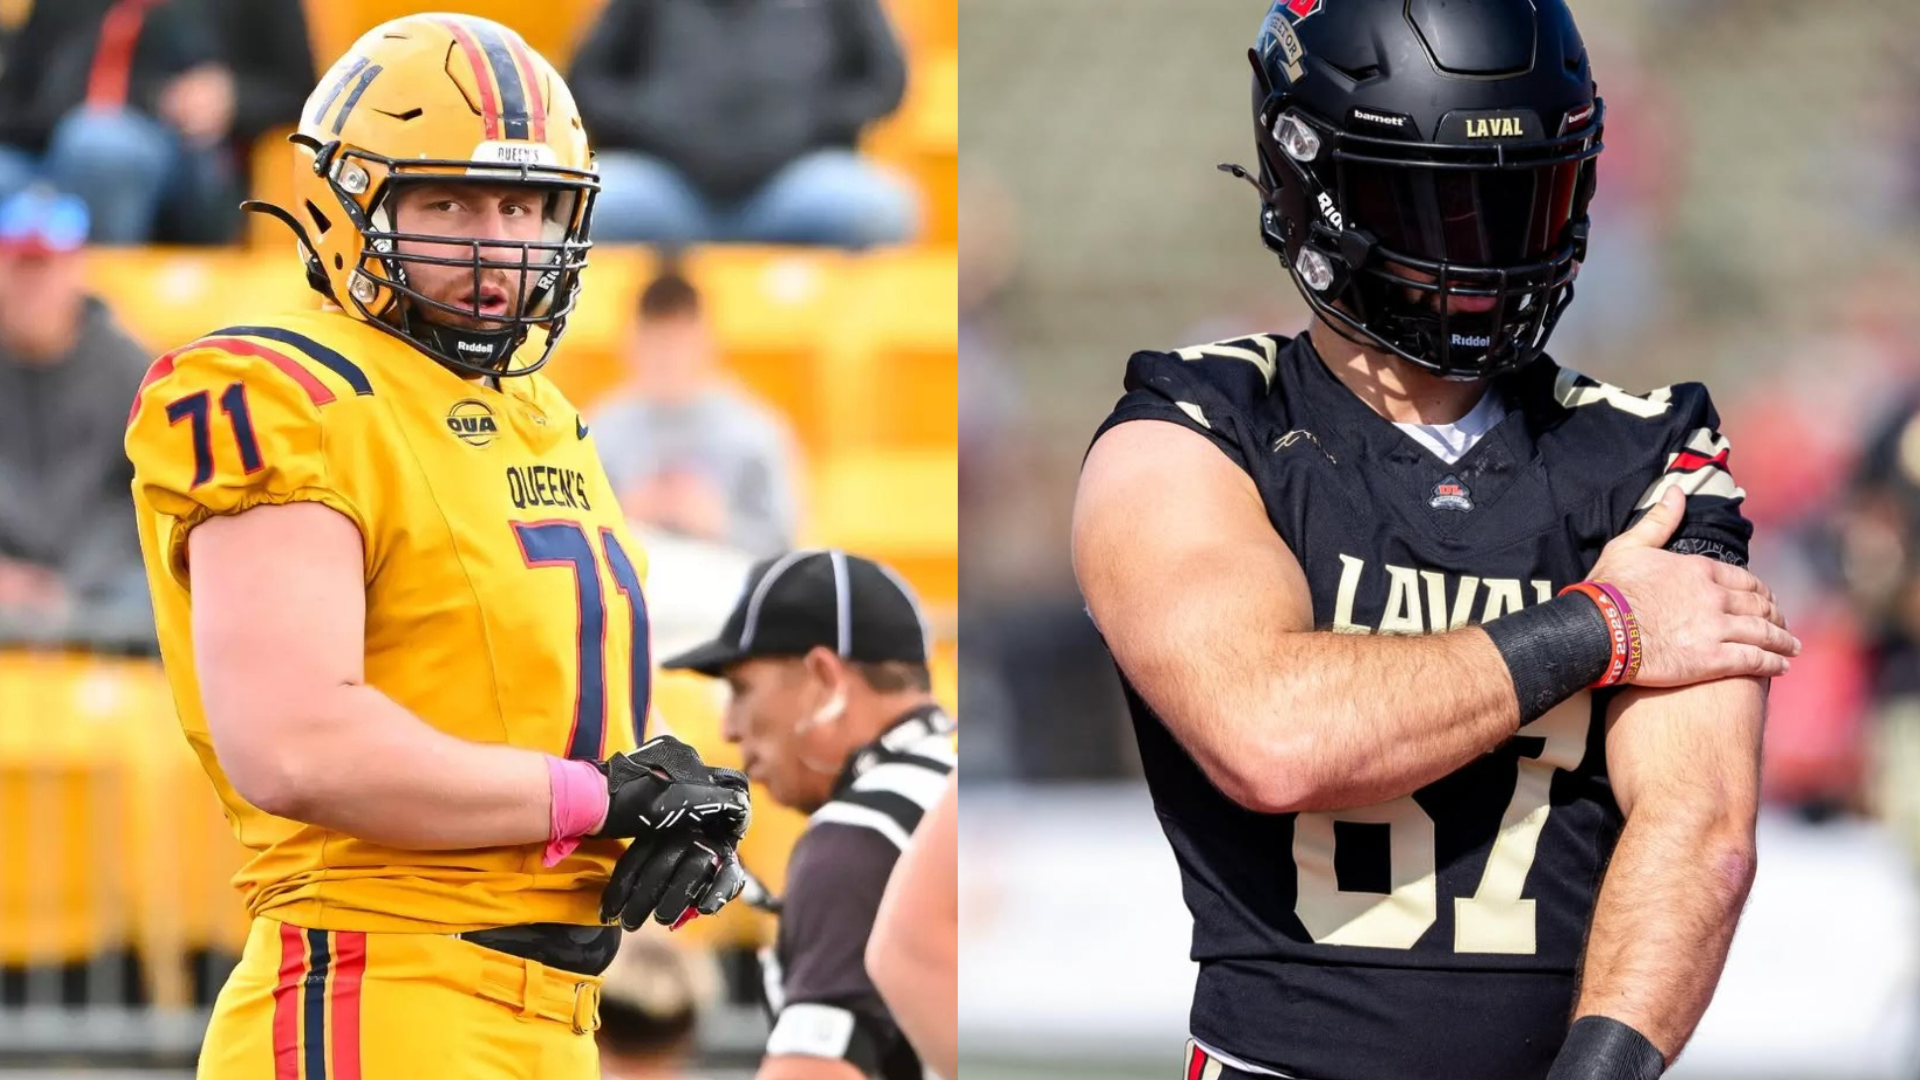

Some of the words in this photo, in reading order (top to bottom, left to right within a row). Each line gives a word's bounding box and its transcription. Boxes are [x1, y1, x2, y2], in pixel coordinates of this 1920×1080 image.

[1354, 109, 1405, 126] barnett
[1466, 117, 1523, 138] LAVAL
[458, 340, 494, 353] Riddell
[165, 380, 264, 489] 71
[446, 416, 498, 433] OUA
[506, 465, 592, 511] QUEEN'S
[508, 518, 652, 760] 71
[1605, 607, 1627, 655] 2025
